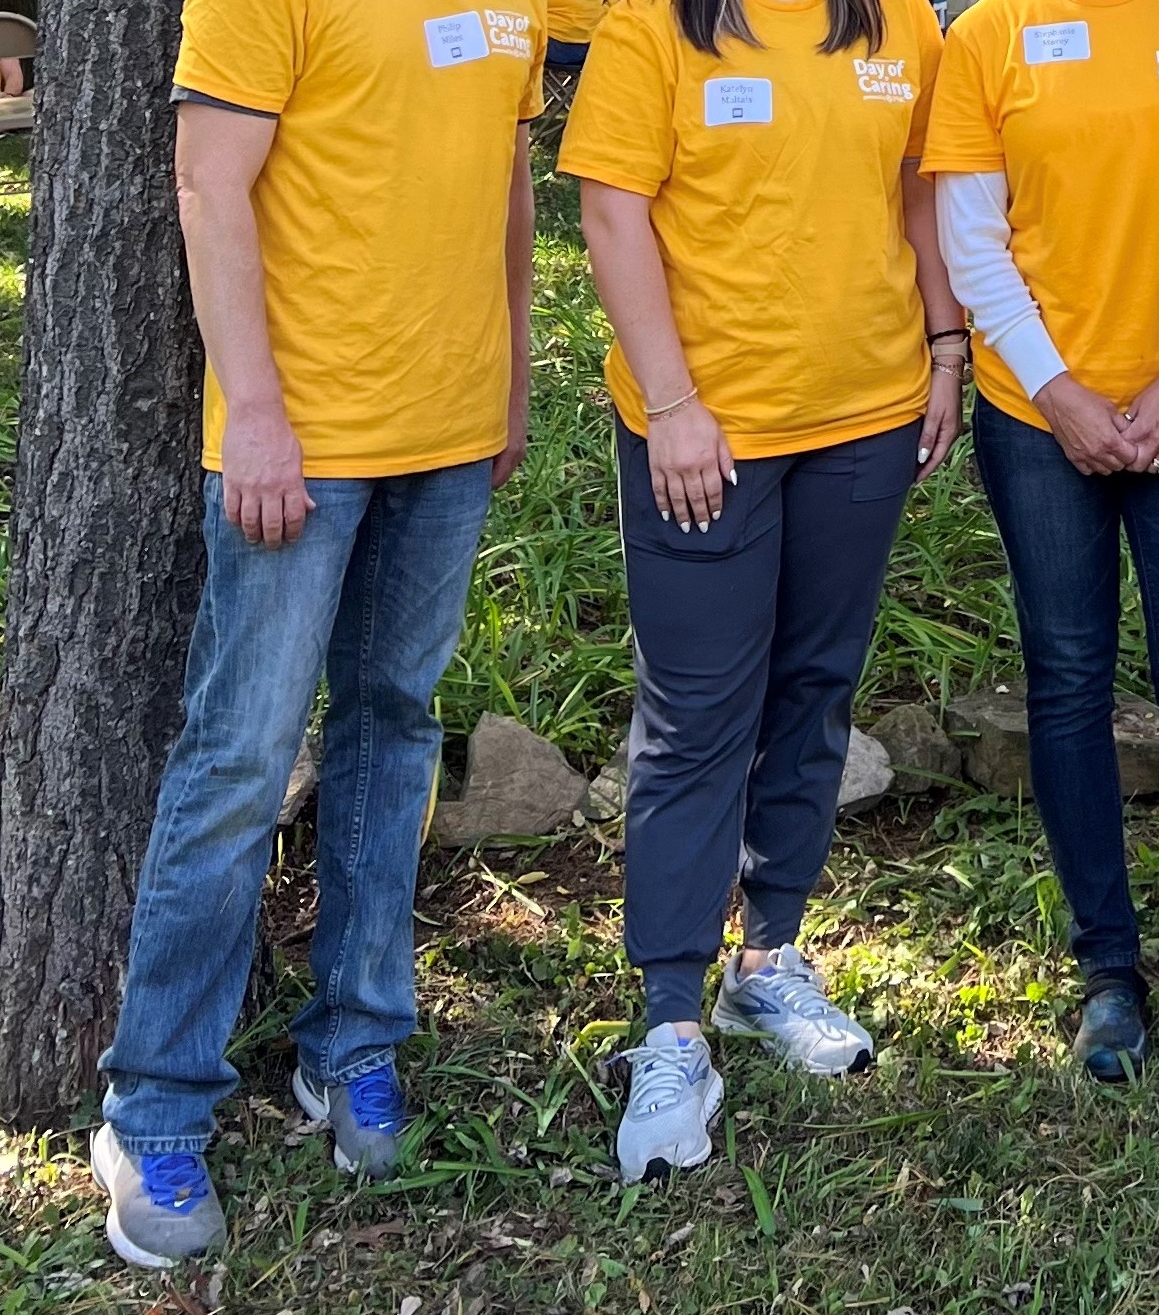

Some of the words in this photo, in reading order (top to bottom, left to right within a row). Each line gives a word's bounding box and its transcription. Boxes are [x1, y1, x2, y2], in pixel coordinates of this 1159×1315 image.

[484, 9, 515, 32] Day
[515, 16, 530, 32] of
[853, 58, 885, 79] Day
[888, 59, 906, 77] of
[858, 76, 914, 100] Caring
